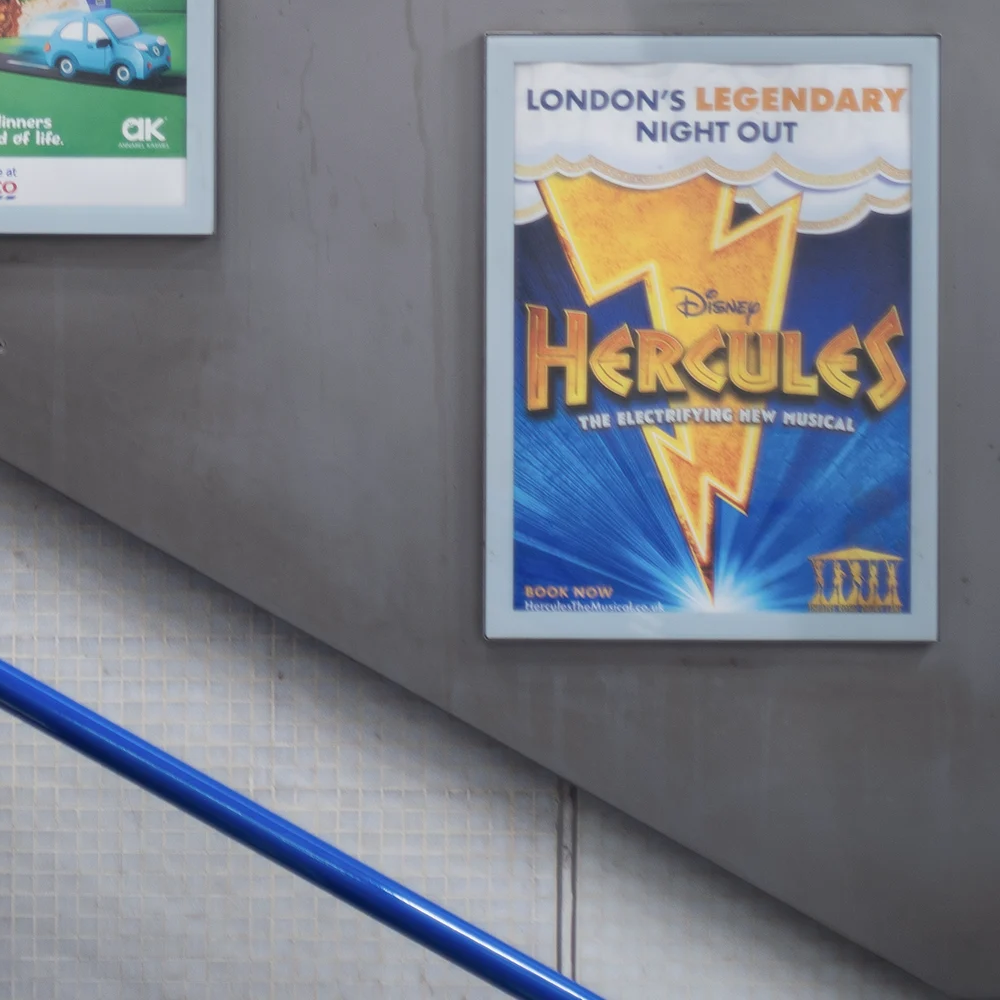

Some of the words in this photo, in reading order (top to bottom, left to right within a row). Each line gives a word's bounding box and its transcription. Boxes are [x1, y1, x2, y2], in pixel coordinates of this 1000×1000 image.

[695, 86, 908, 113] LEGENDARY
[13, 131, 30, 147] of
[35, 131, 64, 147] life.
[635, 120, 731, 144] NIGHT
[737, 120, 799, 144] OUT
[5, 167, 18, 178] at
[524, 303, 908, 412] HERCULES
[577, 413, 612, 431] THE
[617, 408, 734, 428] ELECTRIFYING
[739, 408, 777, 427] NEW
[783, 411, 855, 433] MUSICAL
[524, 585, 569, 599] BOOK
[573, 585, 614, 599] NOW
